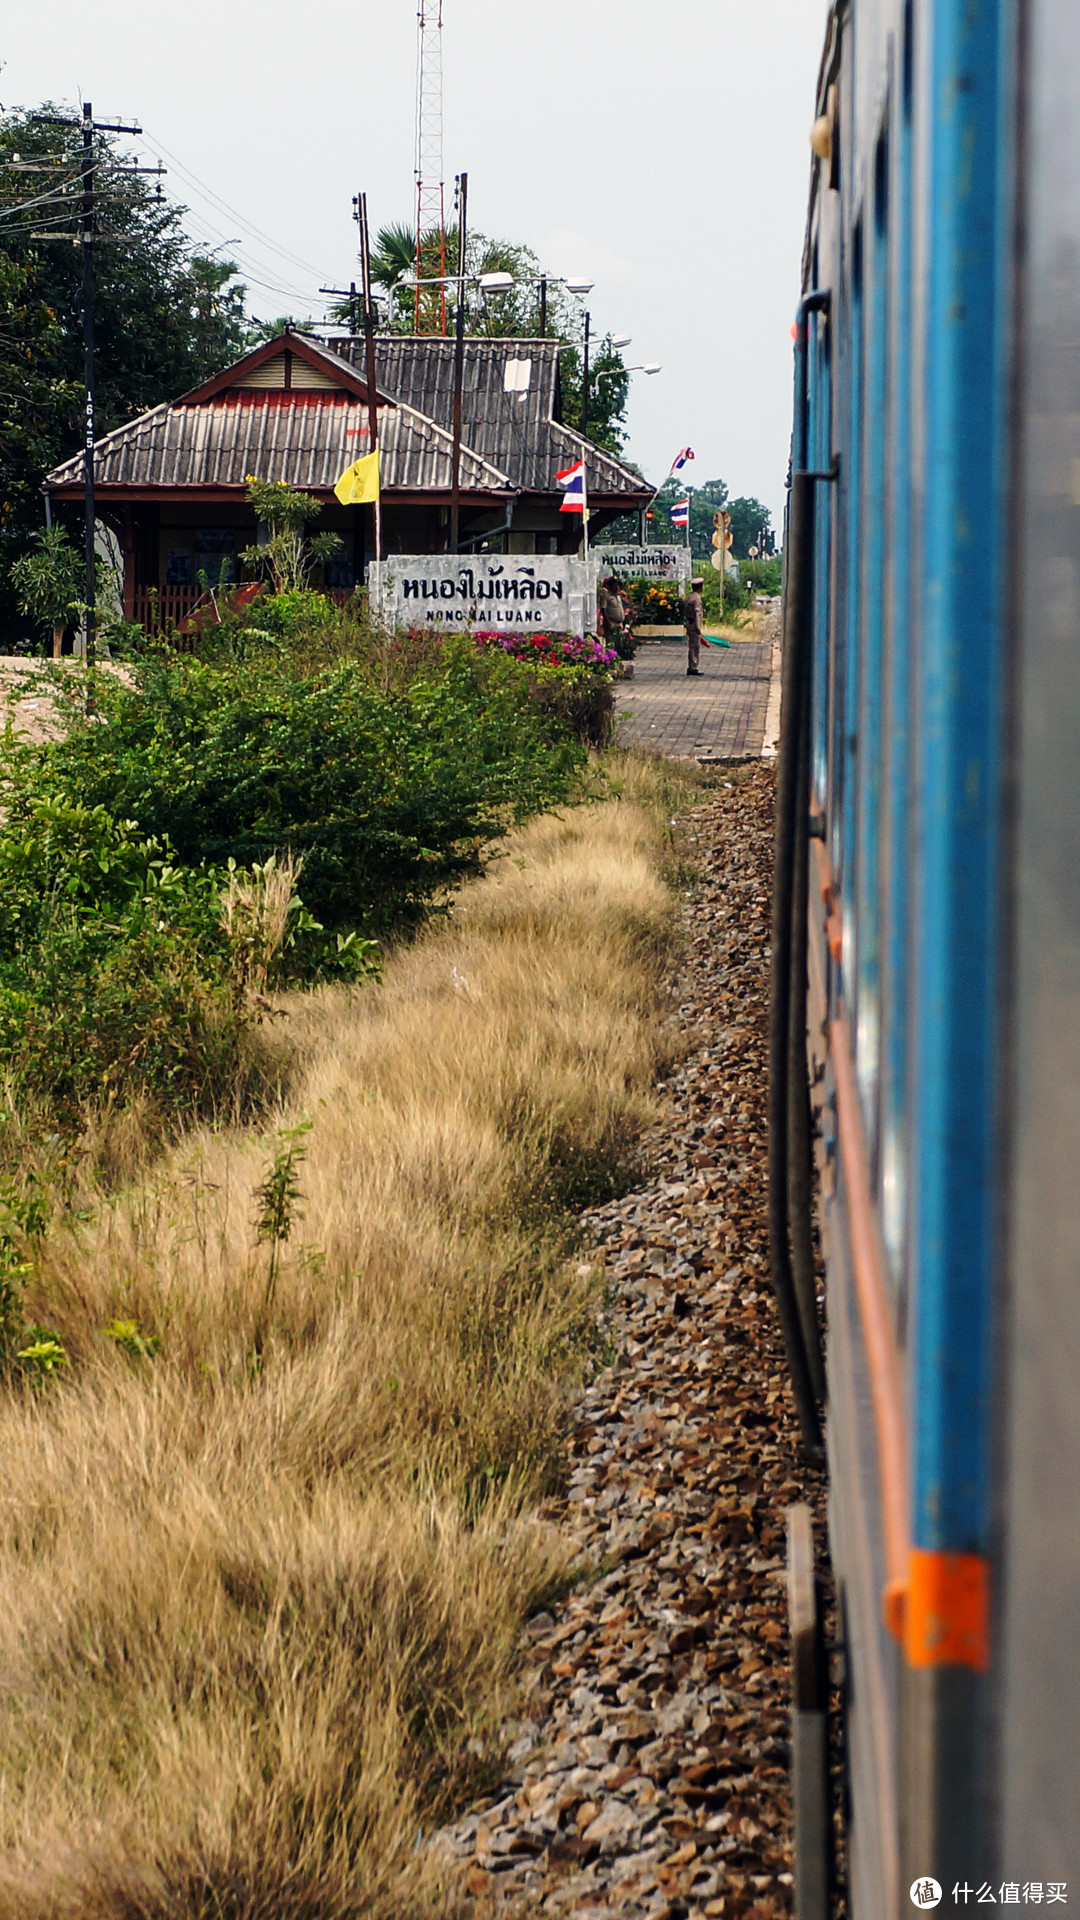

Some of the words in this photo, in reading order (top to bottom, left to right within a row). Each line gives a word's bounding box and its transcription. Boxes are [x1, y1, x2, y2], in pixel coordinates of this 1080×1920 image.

[402, 565, 563, 600] หนองไม้เหลือง
[426, 610, 464, 621] NONG
[496, 610, 542, 622] LUANG
